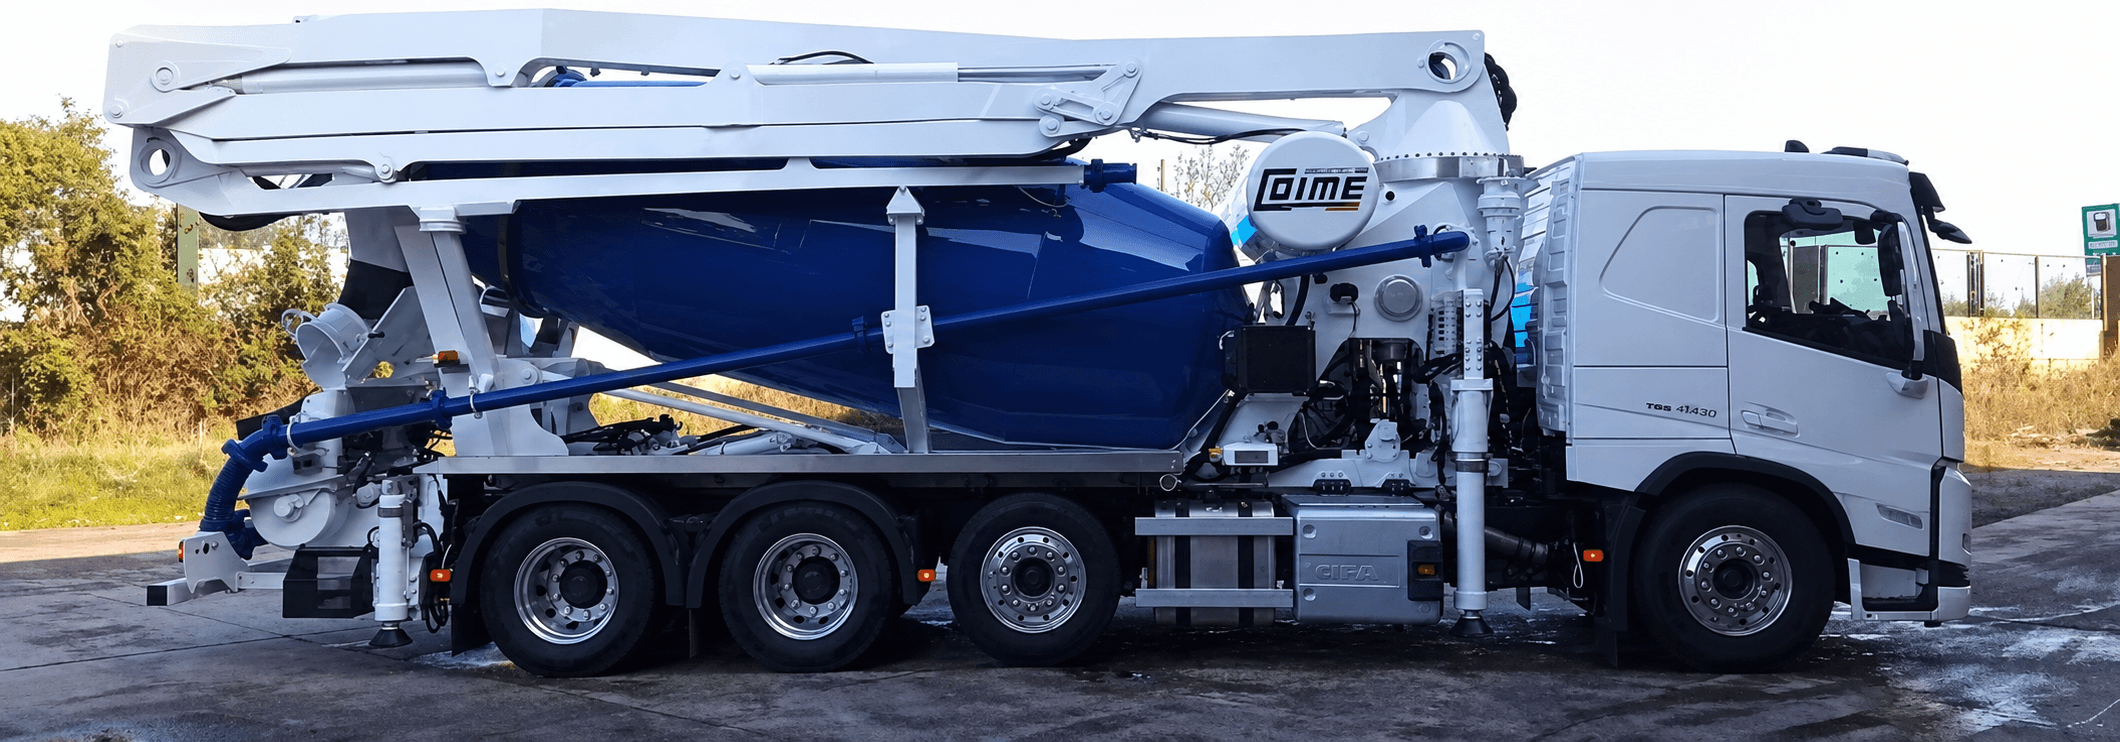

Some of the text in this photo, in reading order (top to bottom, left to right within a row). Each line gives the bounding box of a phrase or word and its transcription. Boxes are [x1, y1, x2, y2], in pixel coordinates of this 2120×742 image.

[1254, 168, 1368, 211] COIME
[1646, 402, 1717, 418] TGS 41.430
[1315, 563, 1379, 581] CIFA
